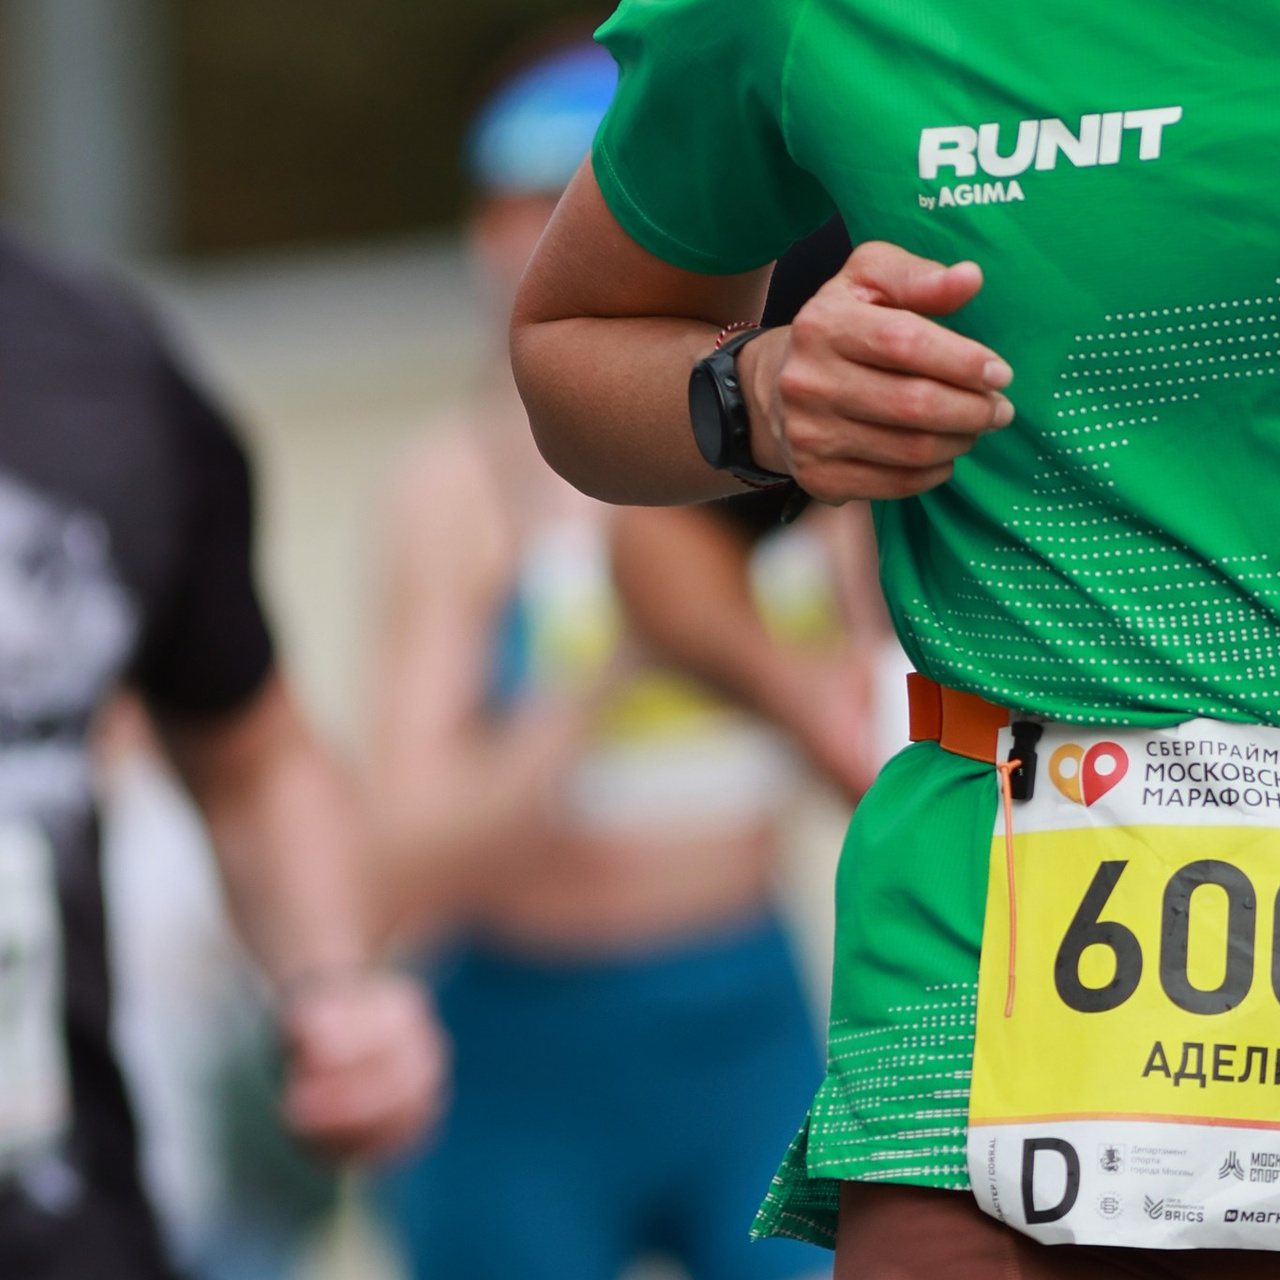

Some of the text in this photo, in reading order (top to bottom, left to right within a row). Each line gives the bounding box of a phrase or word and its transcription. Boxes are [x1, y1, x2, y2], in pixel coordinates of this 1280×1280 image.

[918, 105, 1183, 179] RUNIT
[918, 179, 1025, 210] by AGIMA
[1146, 740, 1279, 764] СБЕРПРАЙМ
[987, 1138, 997, 1175] CORRAL
[1021, 1137, 1081, 1224] D
[1164, 1210, 1204, 1223] BRICS
